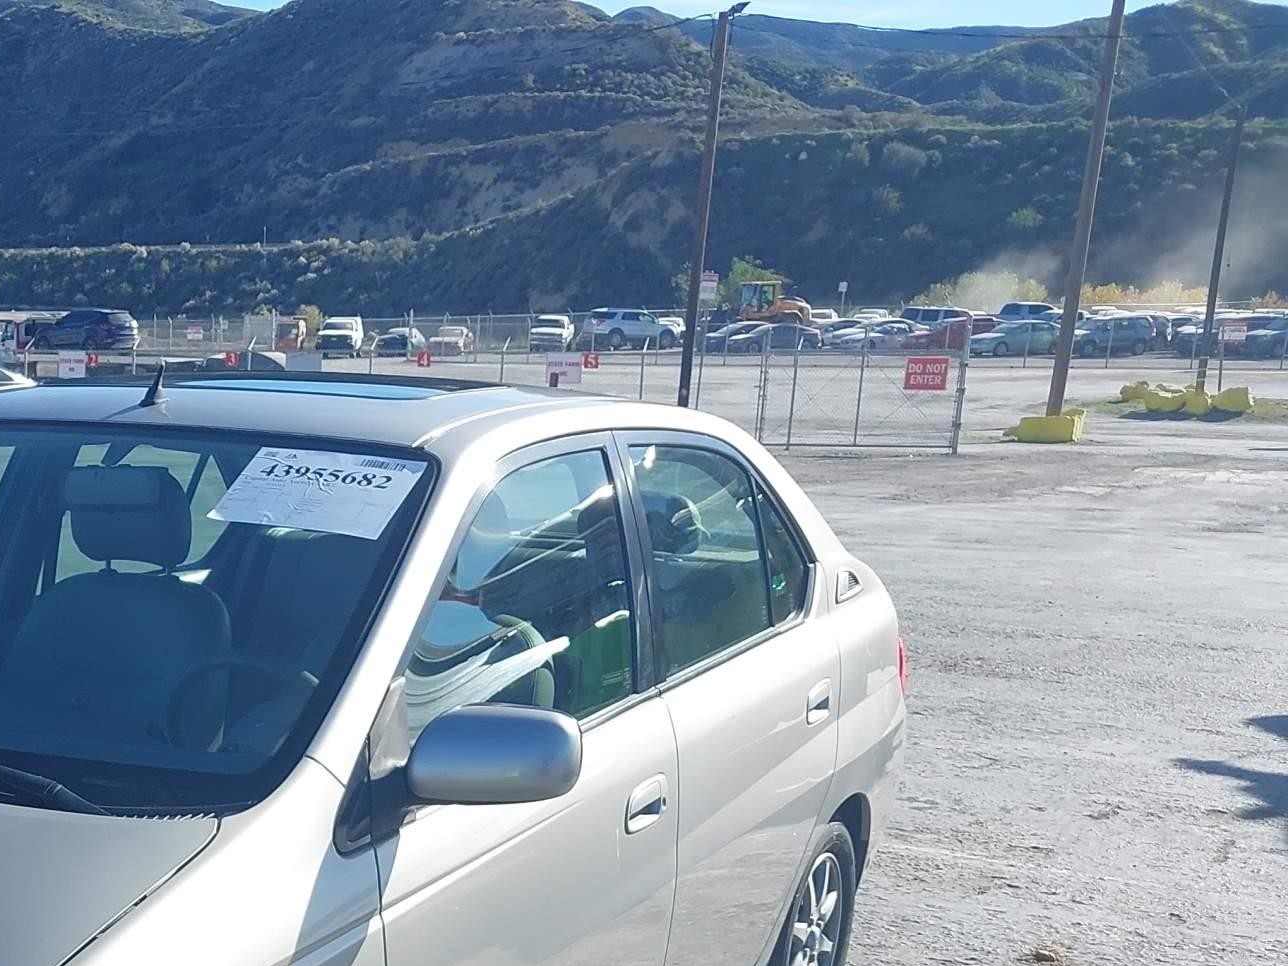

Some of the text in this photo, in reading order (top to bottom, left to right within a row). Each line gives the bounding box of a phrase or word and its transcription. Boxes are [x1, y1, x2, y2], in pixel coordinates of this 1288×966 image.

[909, 363, 946, 373] DO NOT
[910, 374, 942, 385] ENTER
[259, 463, 393, 489] 43955682
